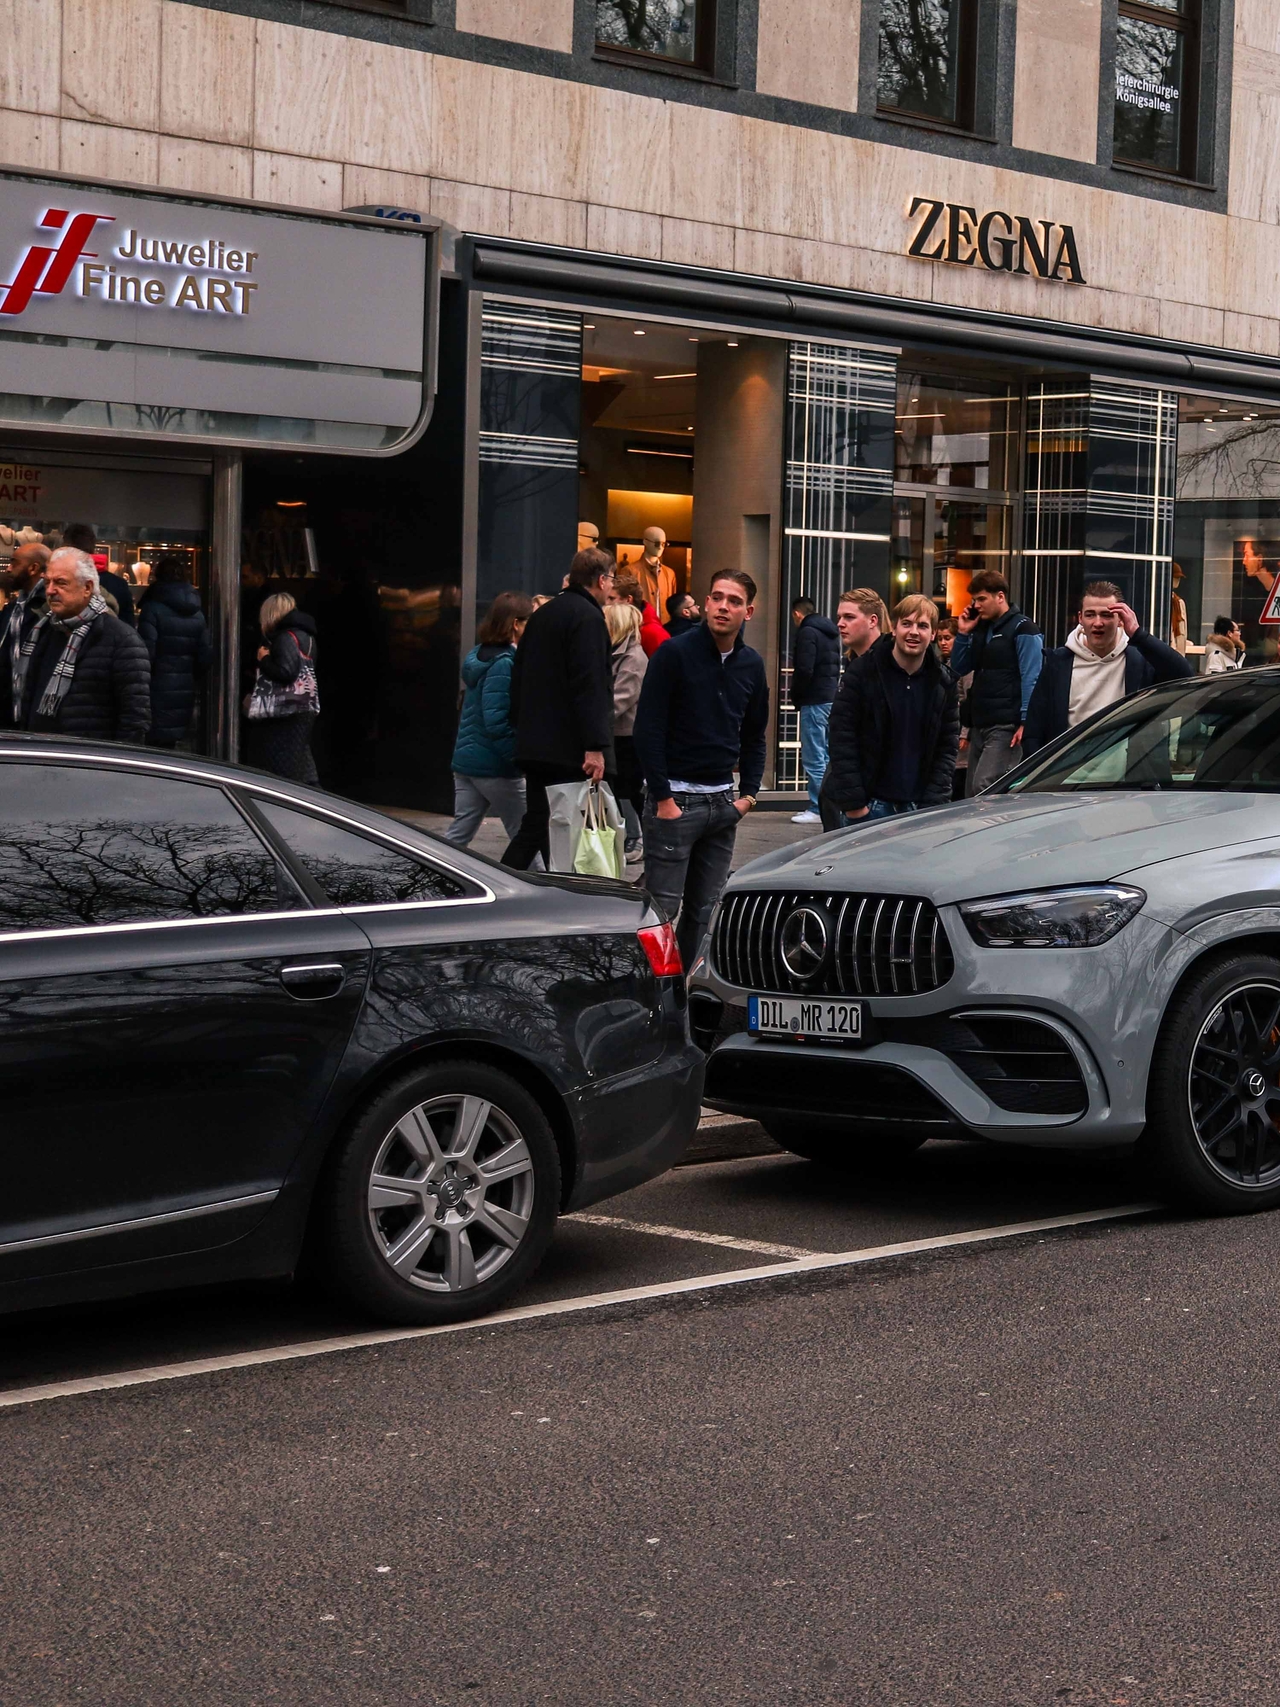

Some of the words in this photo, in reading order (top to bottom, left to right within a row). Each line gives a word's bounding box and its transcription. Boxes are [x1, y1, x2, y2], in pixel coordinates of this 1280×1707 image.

[1116, 88, 1171, 112] Königsallee
[119, 229, 259, 273] Juwelier
[908, 197, 1087, 284] ZEGNA
[82, 262, 166, 305] Fine
[175, 275, 259, 315] ART
[0, 484, 42, 502] ART
[752, 1016, 756, 1024] D
[760, 1001, 788, 1029] DIL
[801, 1003, 822, 1032] MR
[827, 1005, 860, 1034] 120
